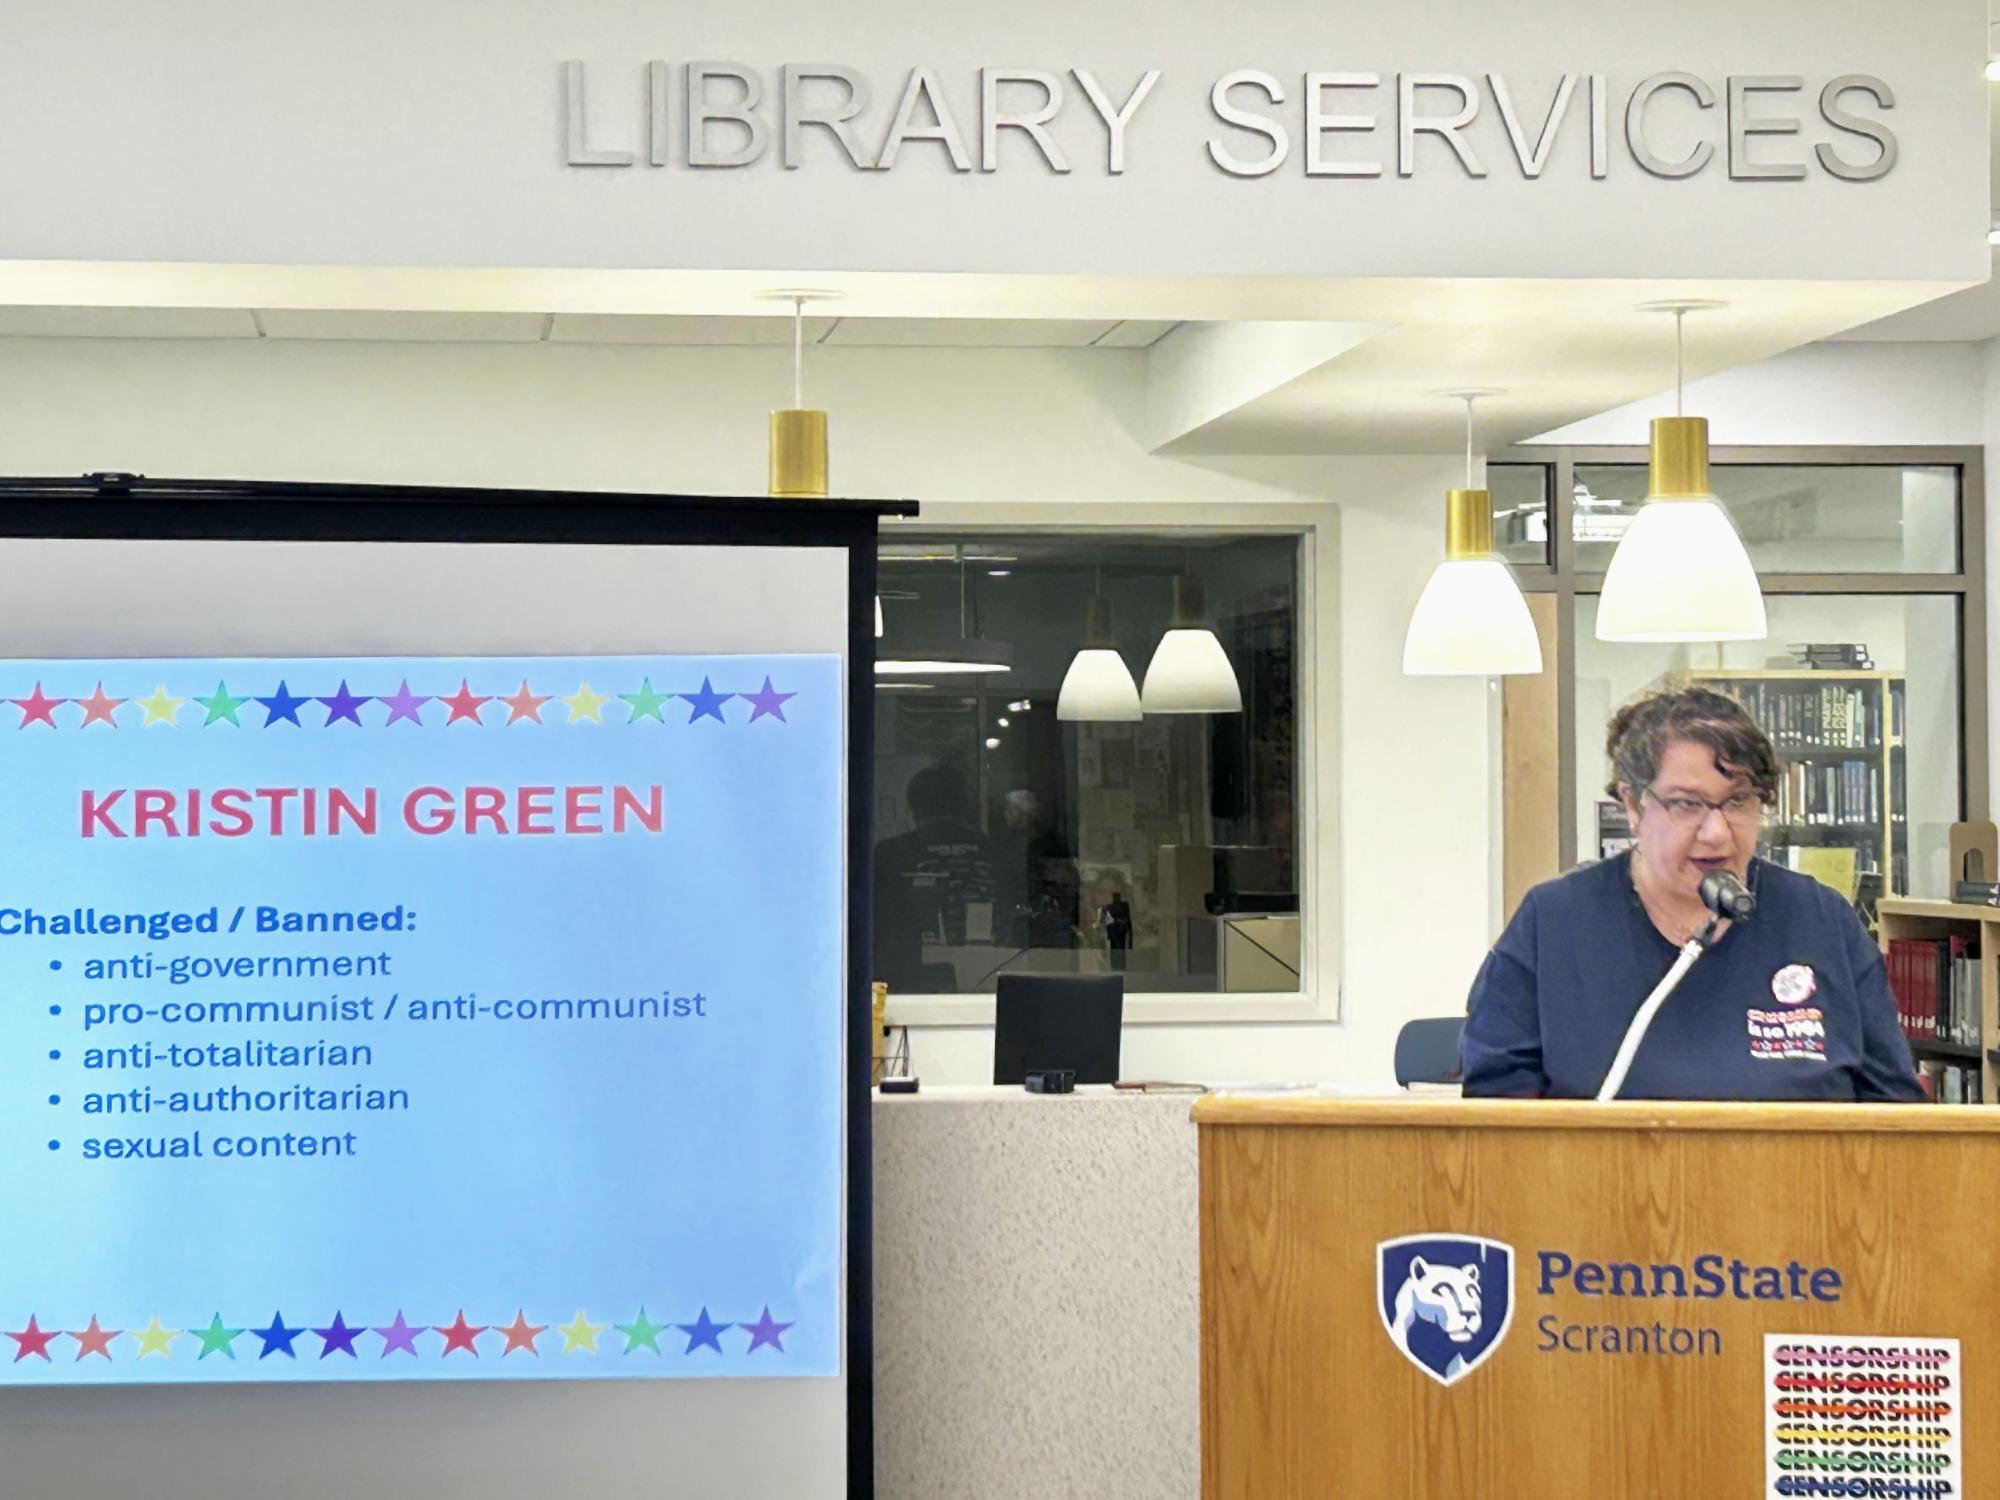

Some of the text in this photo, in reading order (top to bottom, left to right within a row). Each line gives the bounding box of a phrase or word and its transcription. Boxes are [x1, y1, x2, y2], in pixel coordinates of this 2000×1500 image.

[561, 59, 1899, 182] LIBRARY SERVICES
[81, 785, 665, 838] KRISTIN GREEN
[0, 904, 418, 941] Challenged / Banned:
[84, 951, 392, 985] anti-government
[84, 992, 706, 1028] pro-communist / anti-communist
[83, 1039, 372, 1069] anti-totalitarian
[83, 1083, 409, 1114] anti-authoritarian
[83, 1130, 357, 1159] sexual content
[1537, 1251, 1842, 1302] PennState
[1538, 1315, 1721, 1356] Scranton
[1774, 1344, 1951, 1370] CENSORSHIP
[1774, 1371, 1951, 1396] CENSORSHIP
[1774, 1397, 1951, 1422] CENSORSHIP
[1774, 1423, 1951, 1449] CENSORSHIP
[1774, 1449, 1951, 1474] CENSORSHIP
[1774, 1474, 1951, 1500] CENSORSHIP
